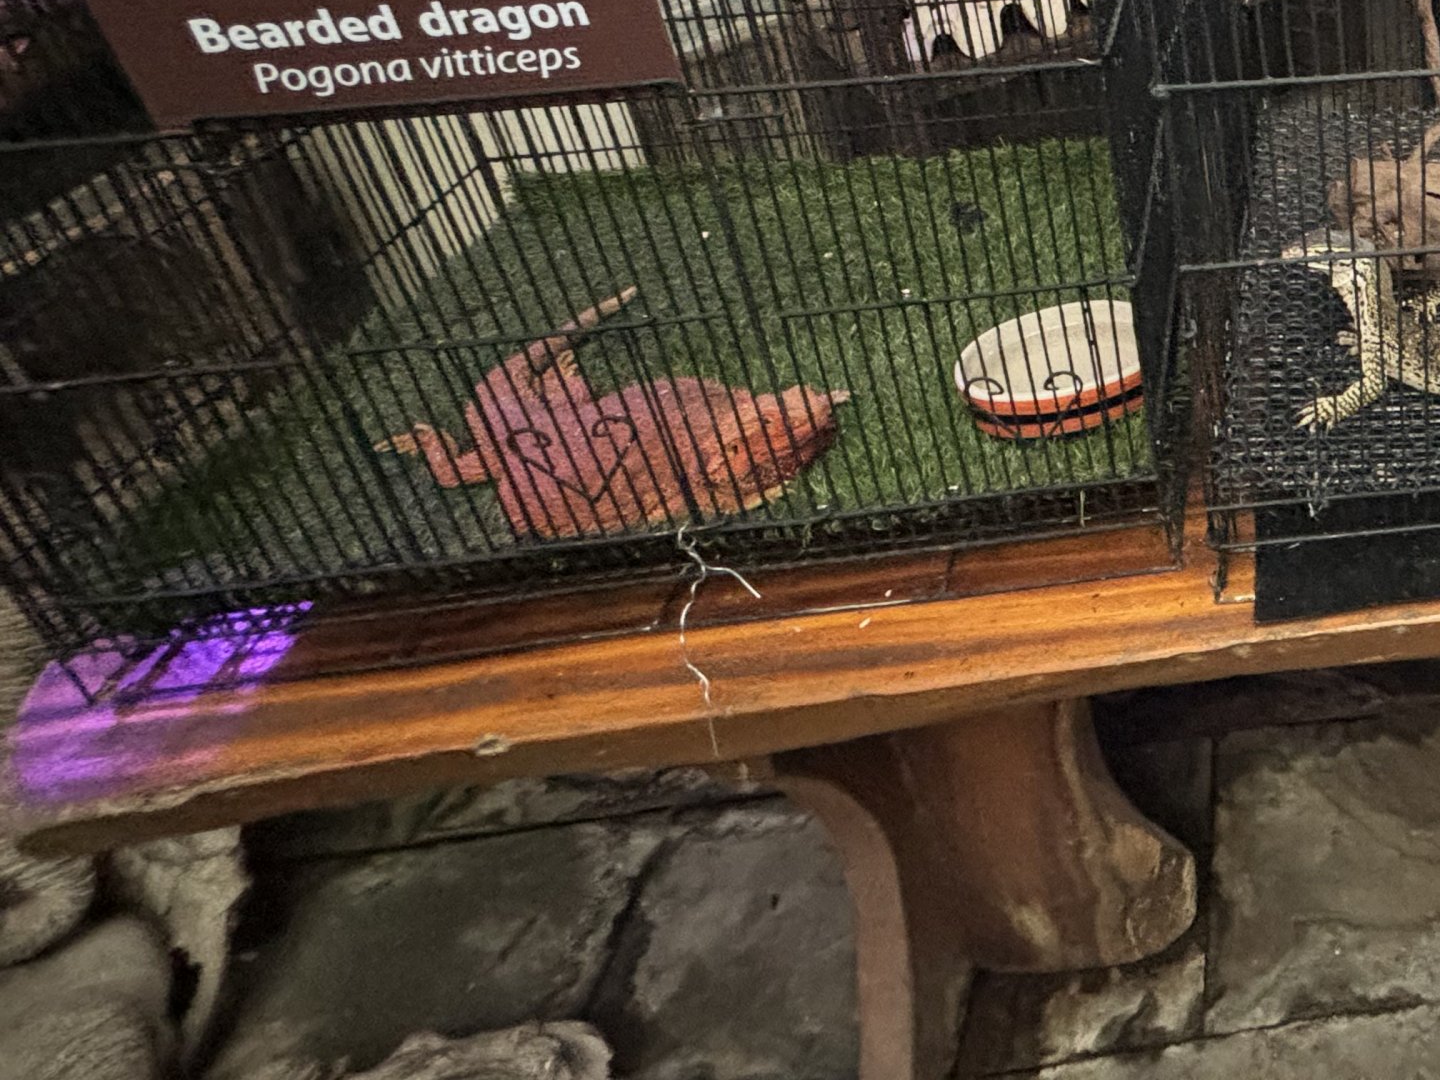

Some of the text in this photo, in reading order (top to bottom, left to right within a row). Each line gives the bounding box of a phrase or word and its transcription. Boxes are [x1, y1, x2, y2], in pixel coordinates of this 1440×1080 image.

[187, 0, 591, 54] Bearded dragon
[253, 46, 582, 97] Pogona vitticeps
